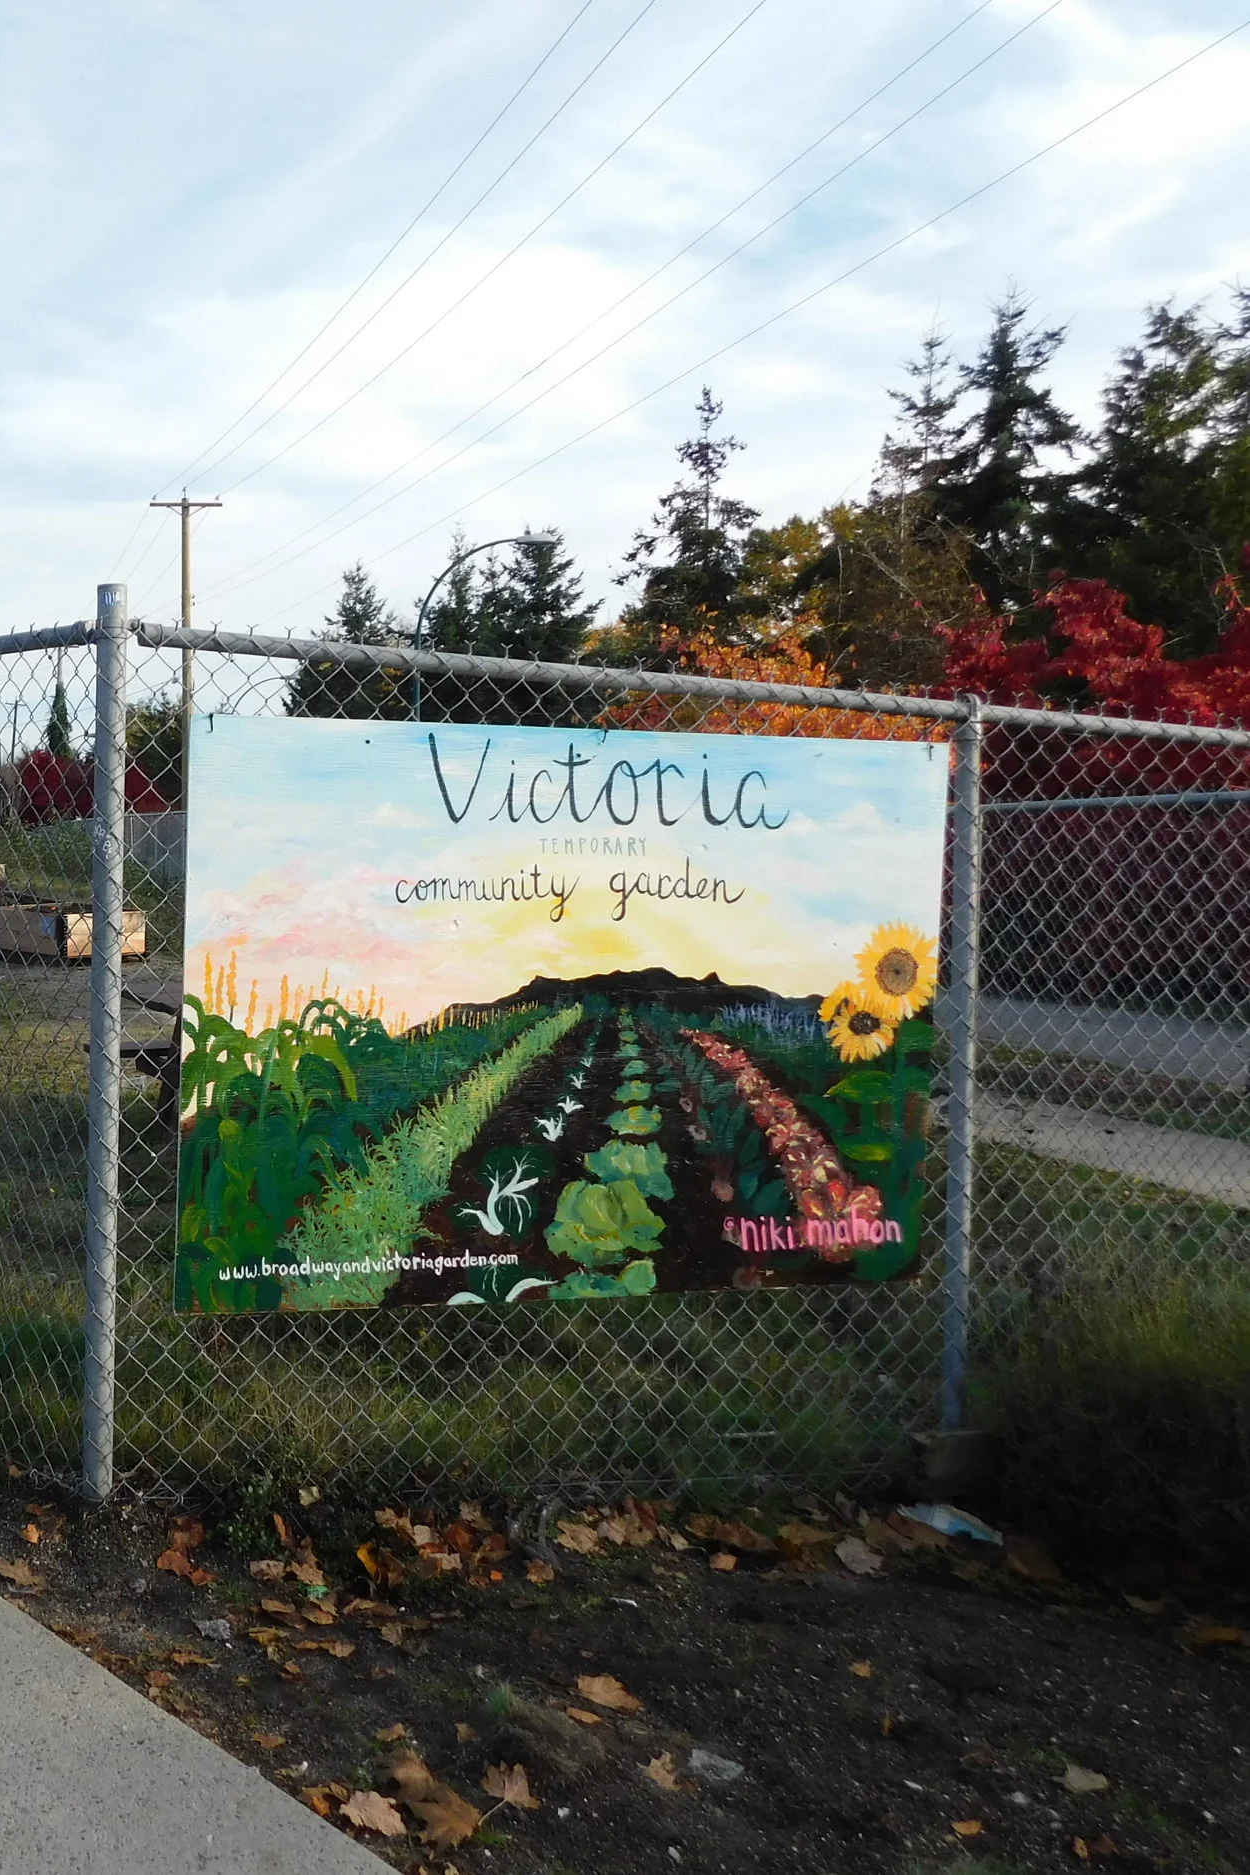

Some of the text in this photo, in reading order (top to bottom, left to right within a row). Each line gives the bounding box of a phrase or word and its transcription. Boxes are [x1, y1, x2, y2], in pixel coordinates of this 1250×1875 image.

[428, 731, 790, 830] Victoria
[539, 836, 647, 857] TEMPORARY
[395, 856, 746, 923] community garden
[806, 1204, 903, 1246] mahon
[218, 1249, 519, 1281] www.broadwayandvictoriagarden.com
